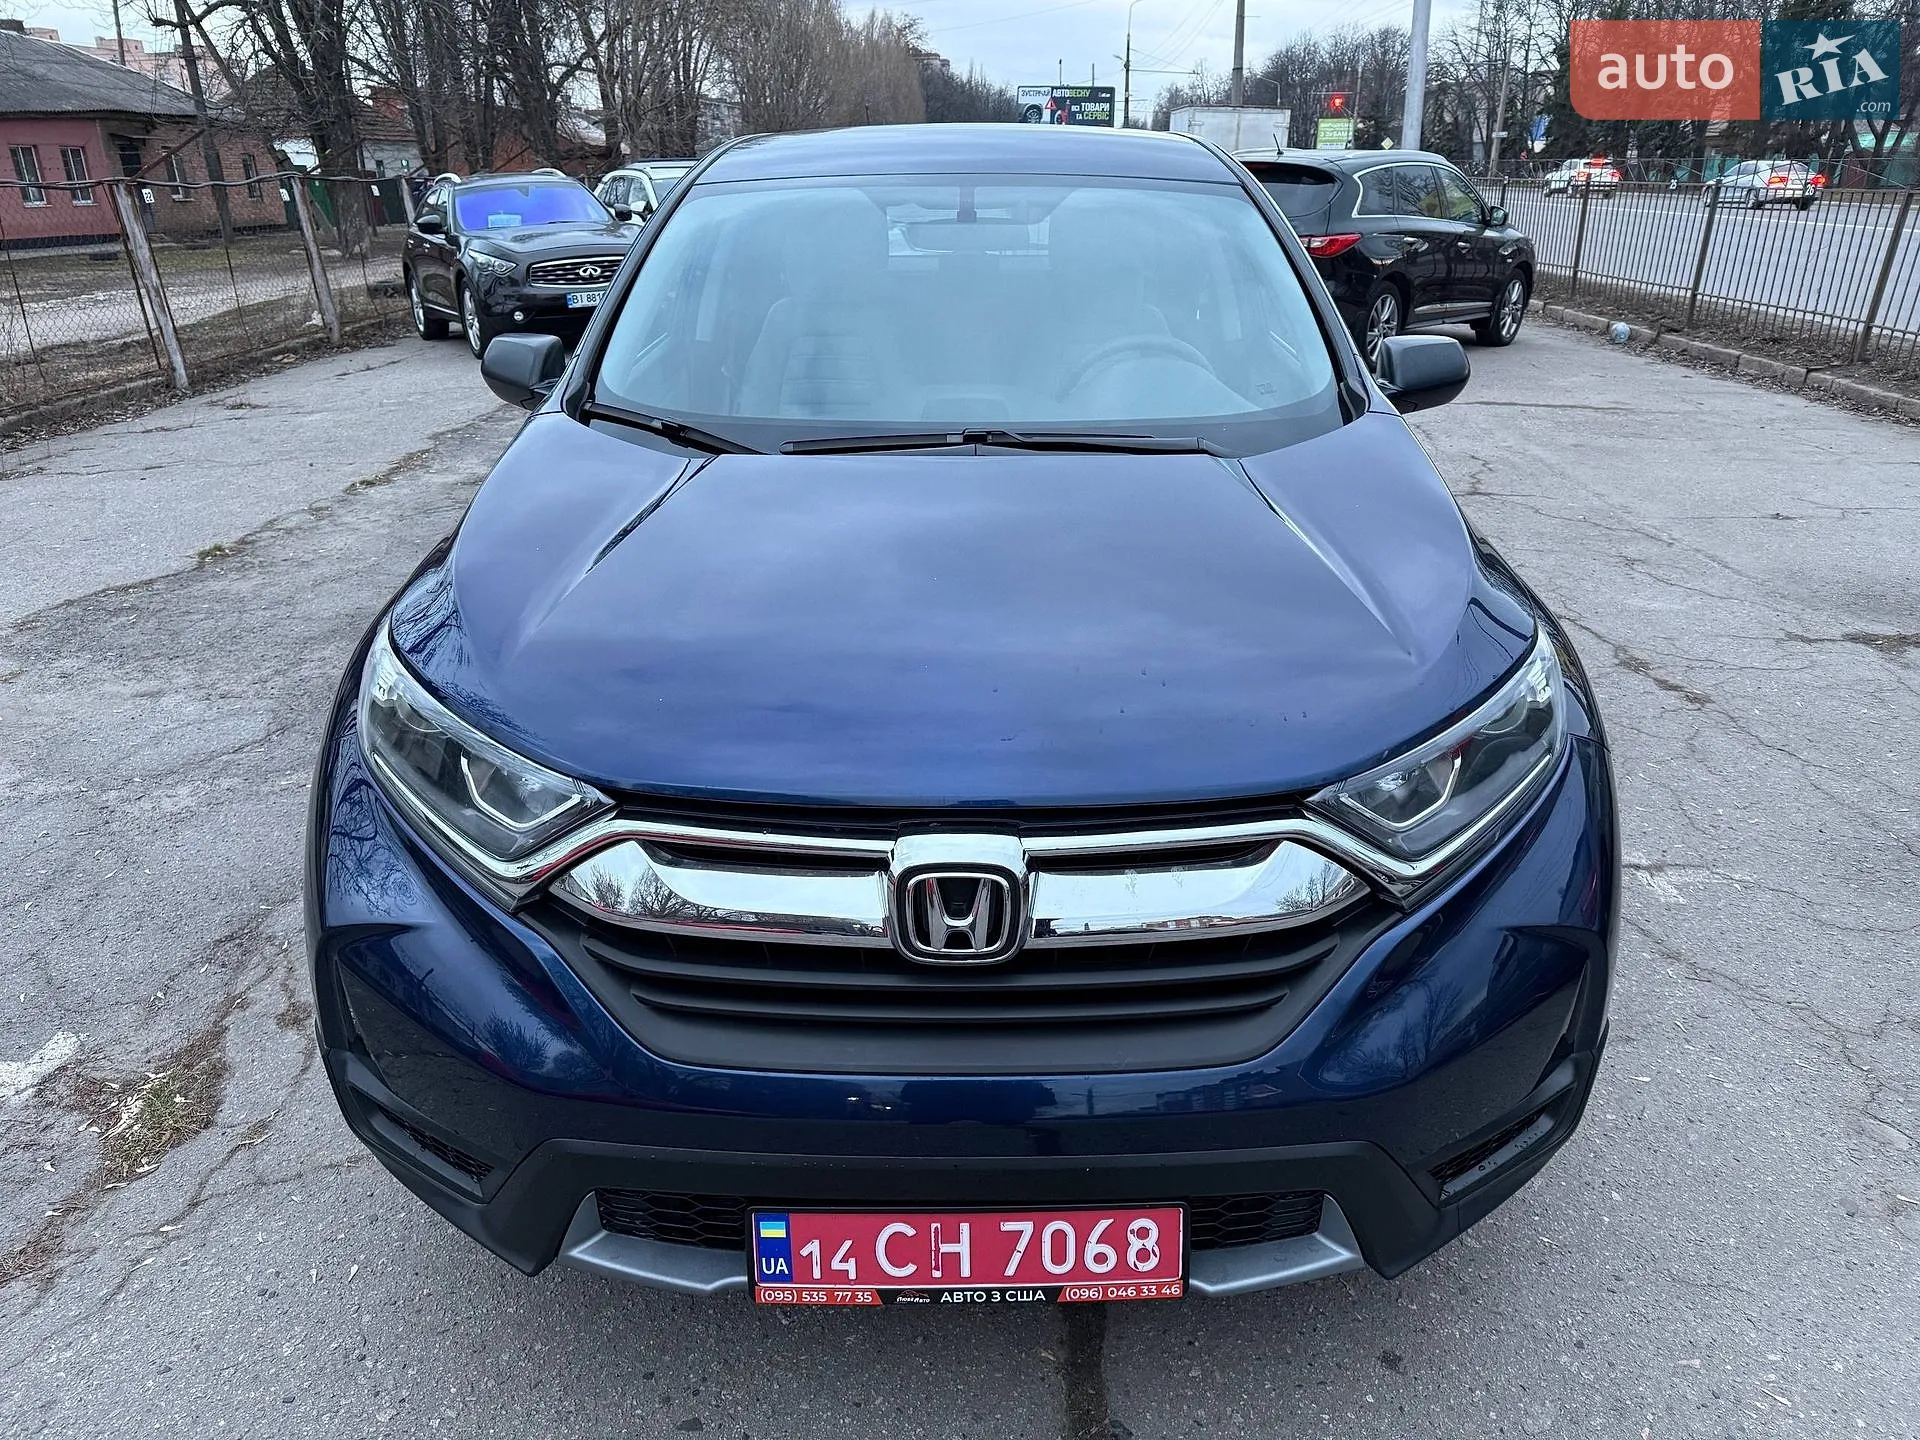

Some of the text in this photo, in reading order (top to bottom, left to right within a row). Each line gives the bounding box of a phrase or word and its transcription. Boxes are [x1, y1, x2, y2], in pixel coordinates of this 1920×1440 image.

[1052, 89, 1091, 97] АВТОВЕСНУ
[1081, 102, 1109, 111] ТОВАРИ
[1083, 111, 1109, 120] СЕРВІС
[1804, 184, 1814, 196] 26
[144, 191, 153, 202] 22
[571, 294, 583, 304] BI
[799, 1218, 1160, 1280] 14 CH 7068
[762, 1256, 789, 1275] UA
[760, 1289, 873, 1303] (095) 535 77 35
[940, 1291, 987, 1303] АВТО
[1005, 1290, 1046, 1302] США
[1065, 1285, 1181, 1301] (096) 046 33 46
